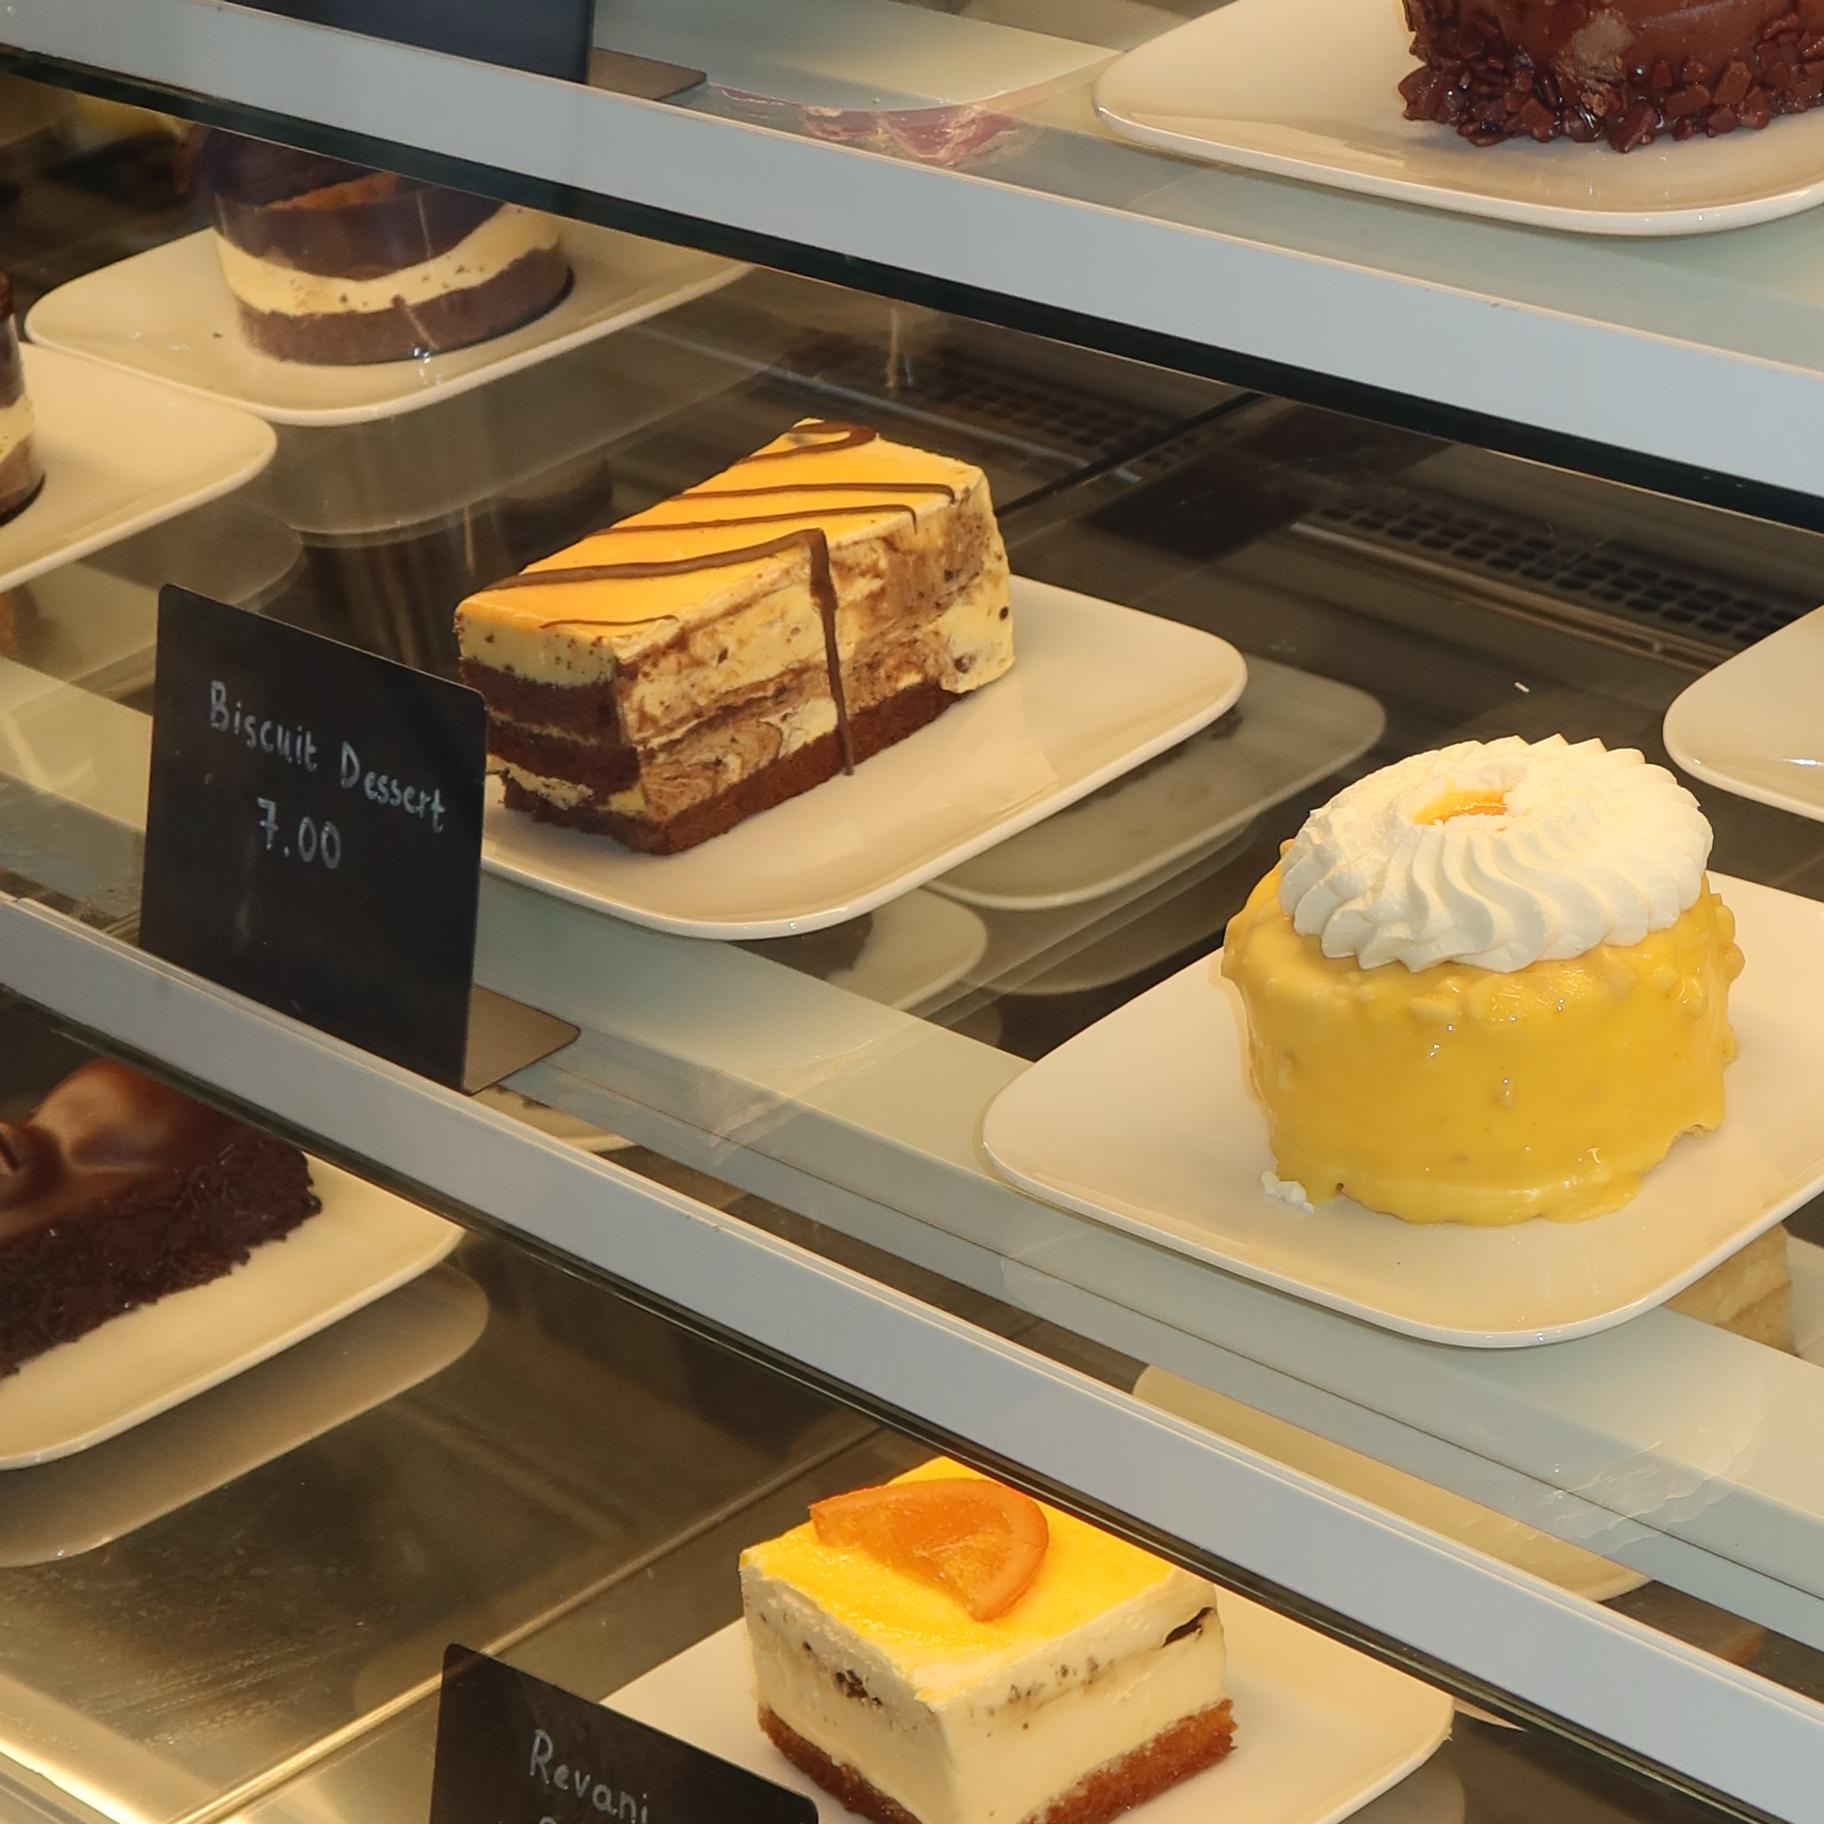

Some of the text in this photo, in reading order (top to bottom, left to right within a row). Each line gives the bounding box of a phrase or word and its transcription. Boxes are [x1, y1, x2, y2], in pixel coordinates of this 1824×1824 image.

[211, 682, 445, 832] Biscuit Dessert
[258, 799, 340, 869] 7.00
